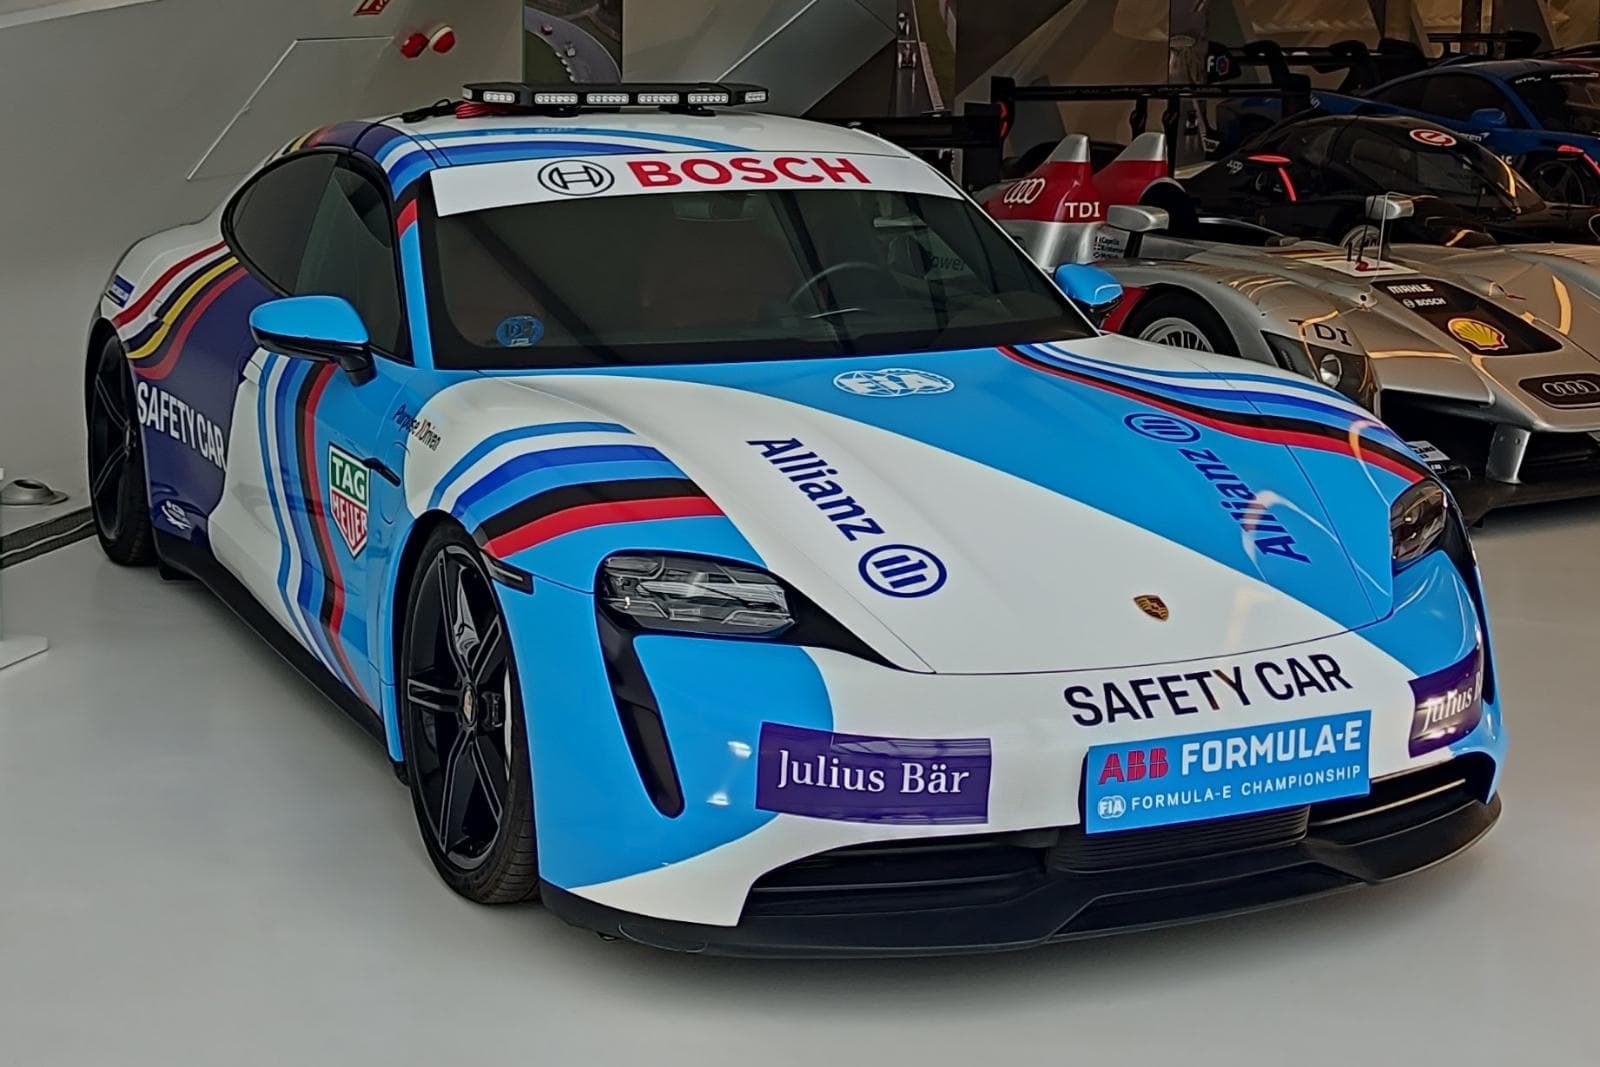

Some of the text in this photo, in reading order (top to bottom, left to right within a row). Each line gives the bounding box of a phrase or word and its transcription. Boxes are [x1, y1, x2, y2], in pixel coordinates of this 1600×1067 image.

[627, 157, 872, 187] BOSCH
[1064, 201, 1101, 219] TDI
[1387, 283, 1434, 295] MAHLE
[1414, 297, 1447, 307] BOSCH
[837, 371, 948, 396] FIA
[137, 381, 228, 472] SAFETY CAR
[332, 455, 365, 501] TAG
[745, 437, 885, 542] Allianz
[331, 492, 368, 548] HEUER
[1176, 448, 1312, 564] Allianz
[1063, 653, 1354, 727] SAFETY CAR
[1421, 686, 1473, 734] Julius
[777, 749, 970, 794] Julius Bär
[1099, 720, 1363, 785] ABB FORMULA-E
[1098, 800, 1126, 817] FIA
[1131, 765, 1361, 811] FORMULA-E CHAMPIONSHIP
